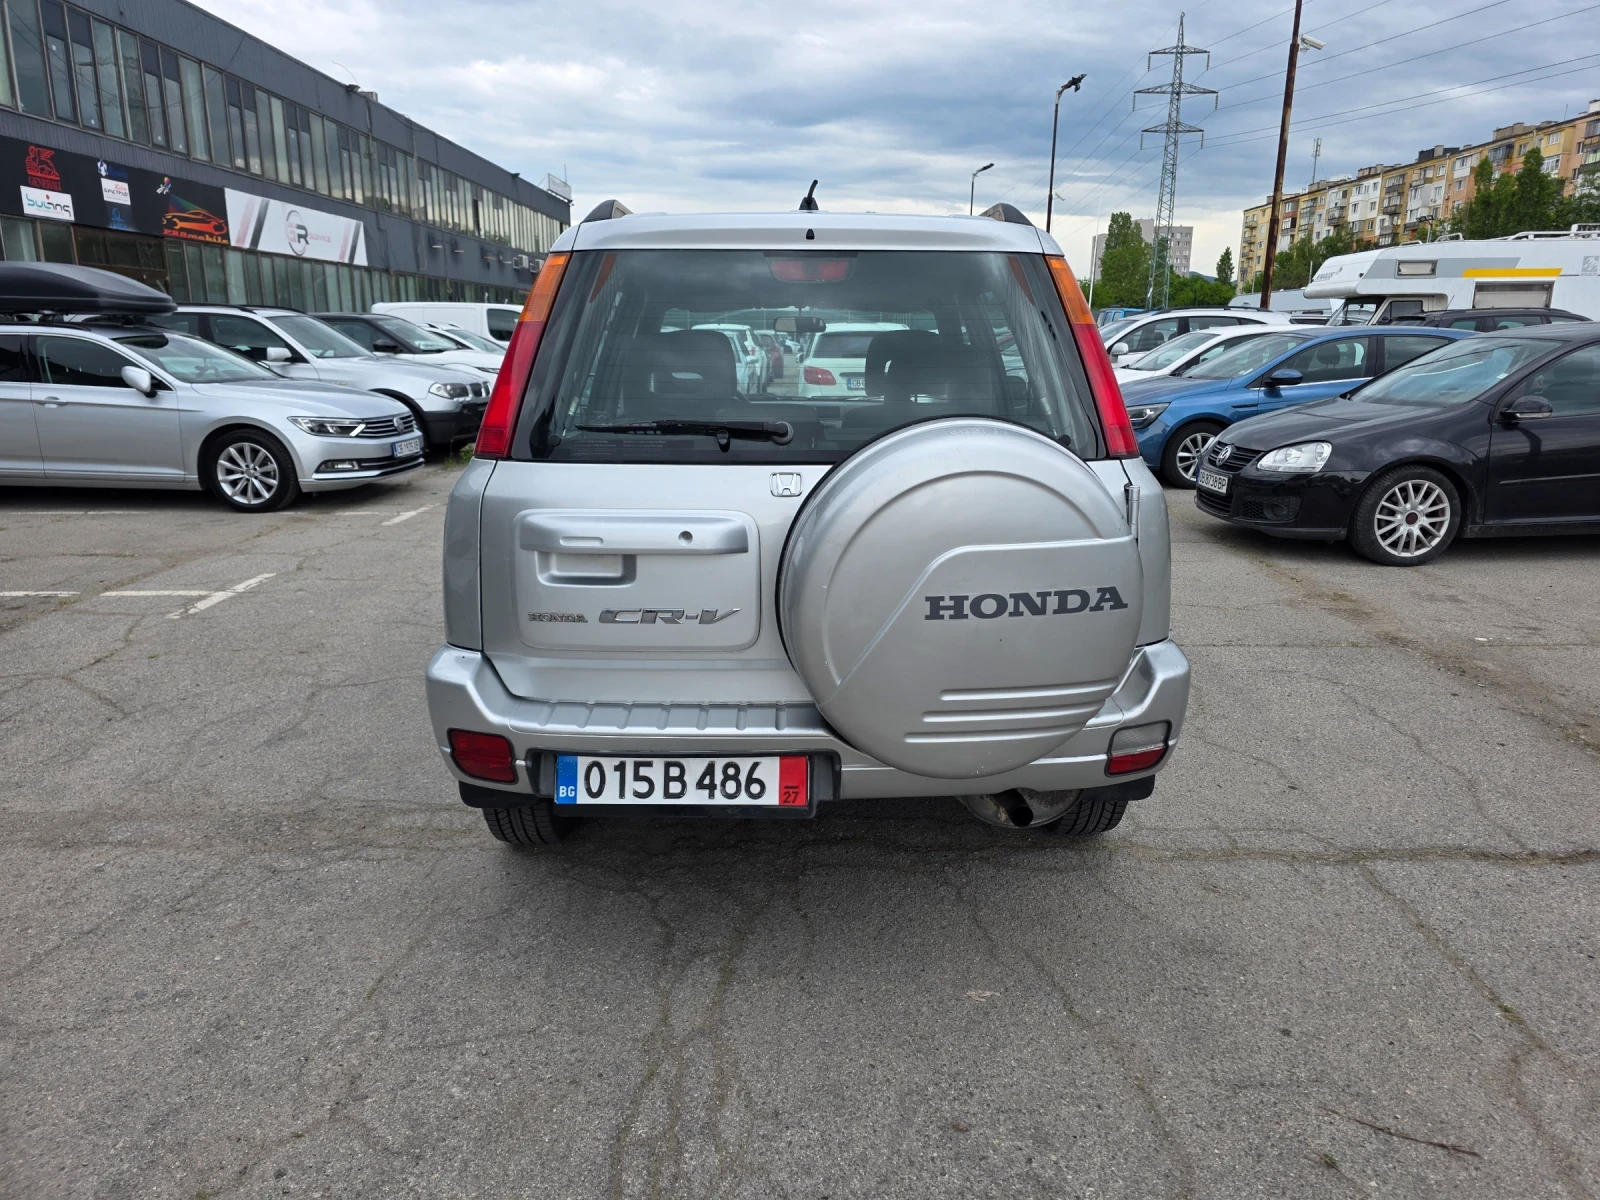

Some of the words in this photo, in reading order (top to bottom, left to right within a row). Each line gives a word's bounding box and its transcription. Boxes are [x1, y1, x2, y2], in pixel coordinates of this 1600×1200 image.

[924, 586, 1129, 621] HONDA
[527, 611, 589, 623] HONDA
[598, 607, 743, 625] CR-V
[558, 785, 576, 798] BG
[782, 790, 799, 804] 27
